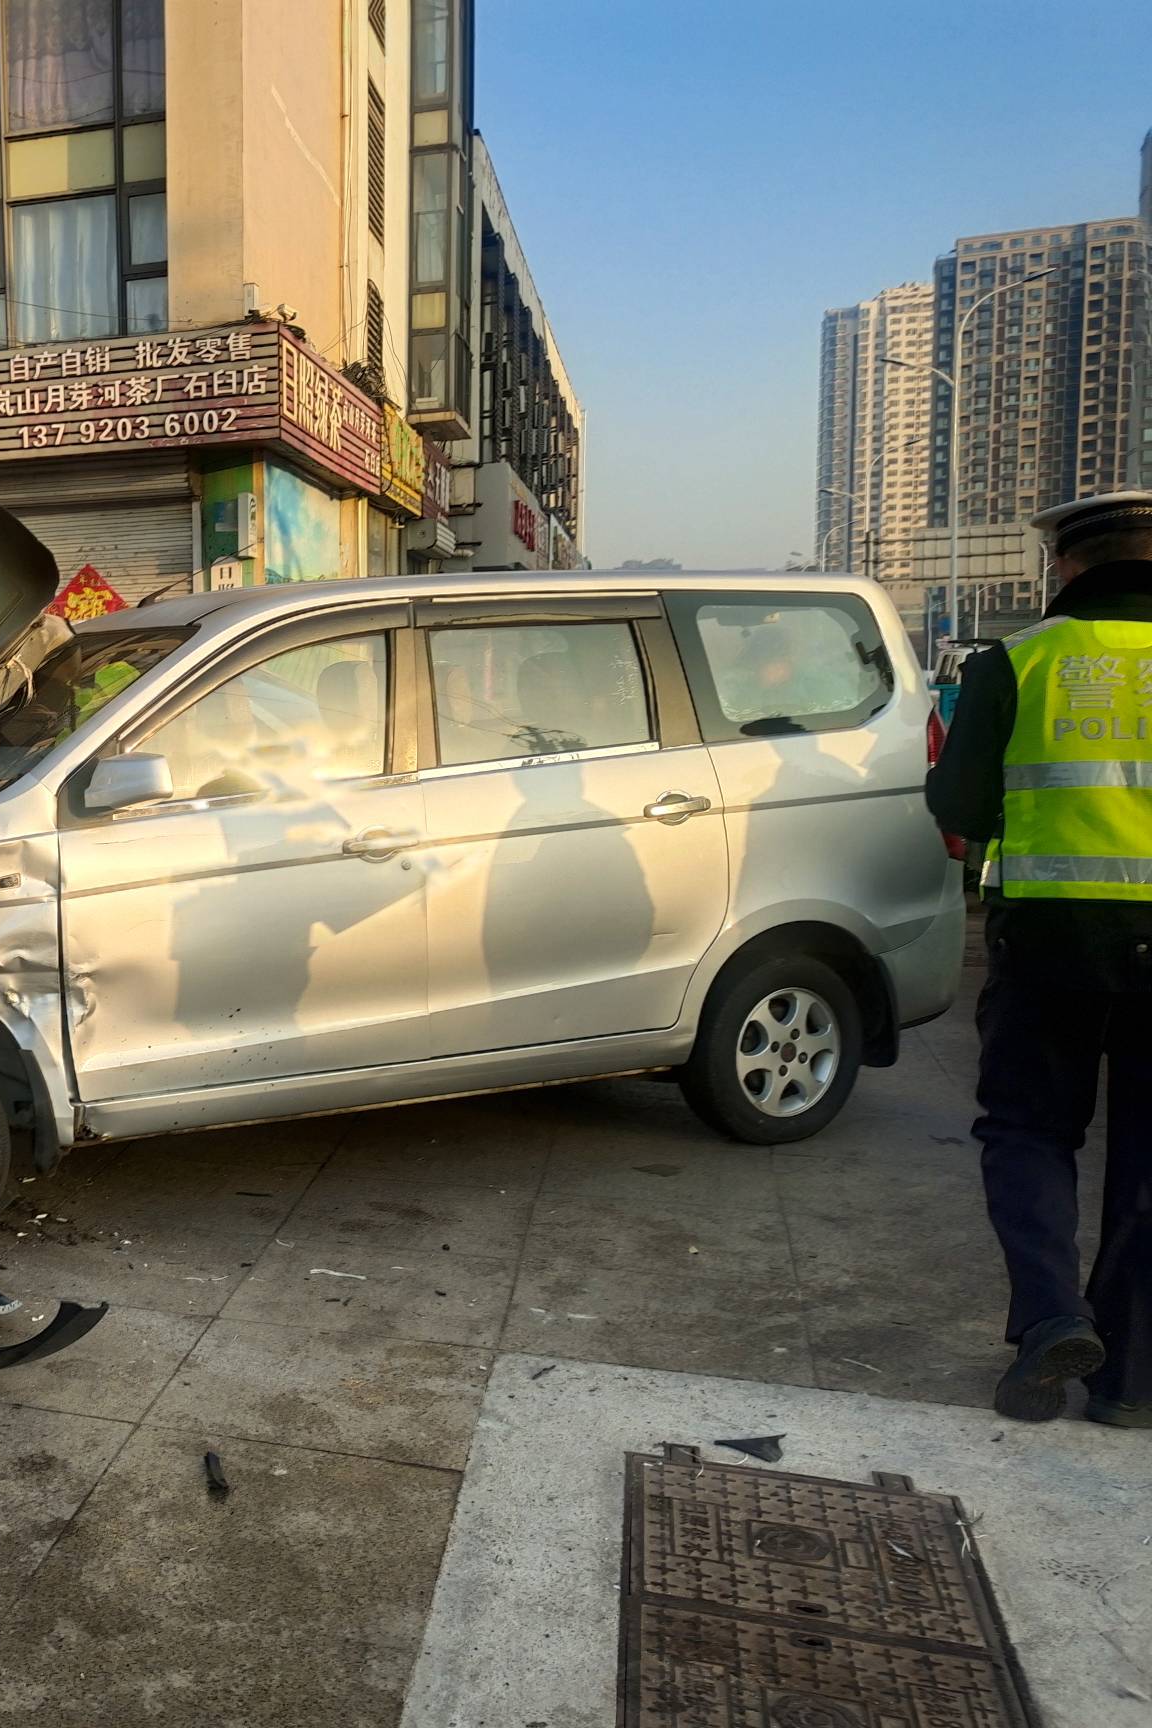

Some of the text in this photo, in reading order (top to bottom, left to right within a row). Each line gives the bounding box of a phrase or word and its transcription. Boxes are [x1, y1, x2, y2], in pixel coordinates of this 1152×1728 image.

[9, 332, 252, 382] 自产自销 批发零售
[282, 339, 342, 452] 日照绿茶
[18, 407, 237, 449] 137 9203 6002
[1058, 654, 1152, 710] 警
[1055, 717, 1147, 740] POLI
